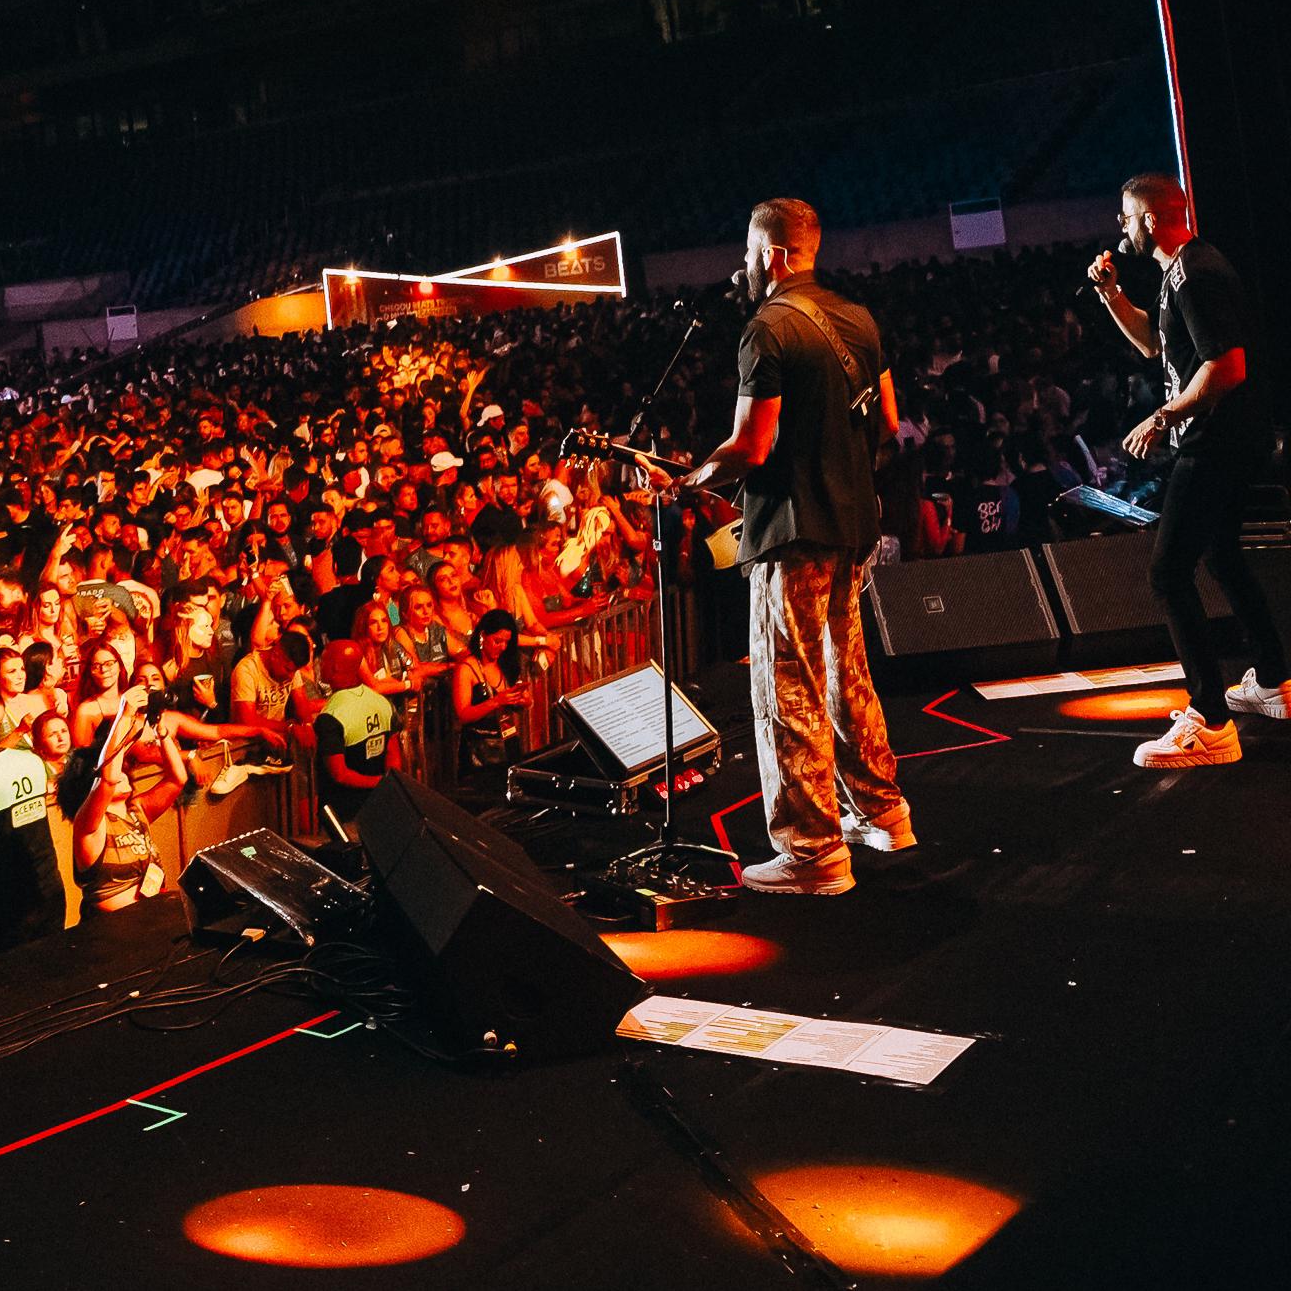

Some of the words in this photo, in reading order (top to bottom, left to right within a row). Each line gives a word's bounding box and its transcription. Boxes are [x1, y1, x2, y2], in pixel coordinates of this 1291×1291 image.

[544, 256, 605, 278] BEATS
[366, 713, 380, 734] 64
[12, 776, 32, 799] 20
